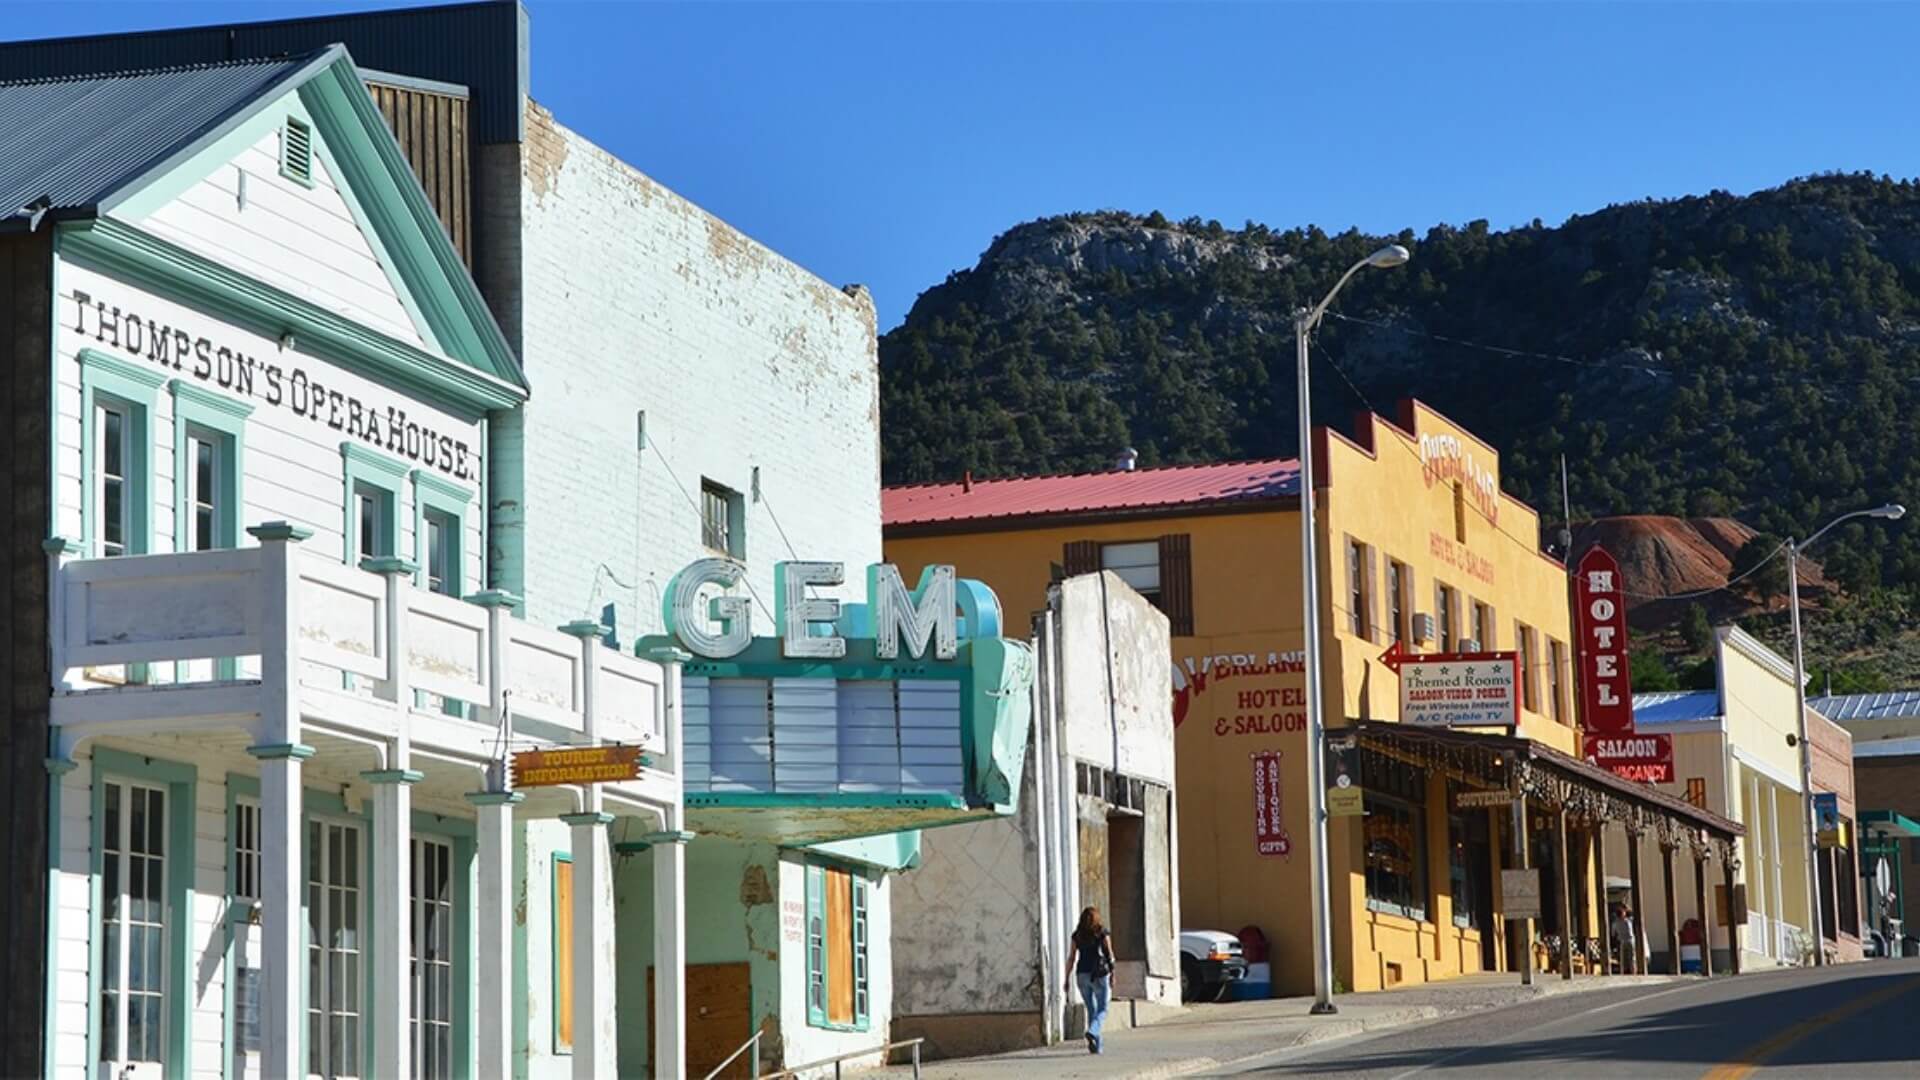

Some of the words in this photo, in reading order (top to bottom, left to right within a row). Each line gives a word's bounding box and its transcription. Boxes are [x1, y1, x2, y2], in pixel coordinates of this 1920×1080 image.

[73, 289, 282, 406] THOMPSON'S
[291, 367, 382, 446] OPERA
[1420, 432, 1498, 527] OVERLAND
[1430, 531, 1456, 567] HOTEL
[1466, 548, 1494, 586] SALOON
[663, 557, 957, 660] GEM
[1588, 570, 1620, 706] HOTEL
[1406, 676, 1460, 688] Themed
[1465, 675, 1512, 687] Rooms
[1237, 688, 1306, 709] HOTEL
[1430, 702, 1469, 710] Wireless
[1472, 700, 1510, 709] Internet
[1214, 717, 1231, 736] &
[1234, 712, 1307, 735] SALOON
[1486, 711, 1503, 720] TV
[543, 749, 608, 766] TOURIST
[1597, 739, 1657, 758] SALOON
[523, 763, 630, 783] INFORMATION
[1268, 760, 1281, 834] ANTIQUES
[1260, 841, 1287, 852] GIFTS
